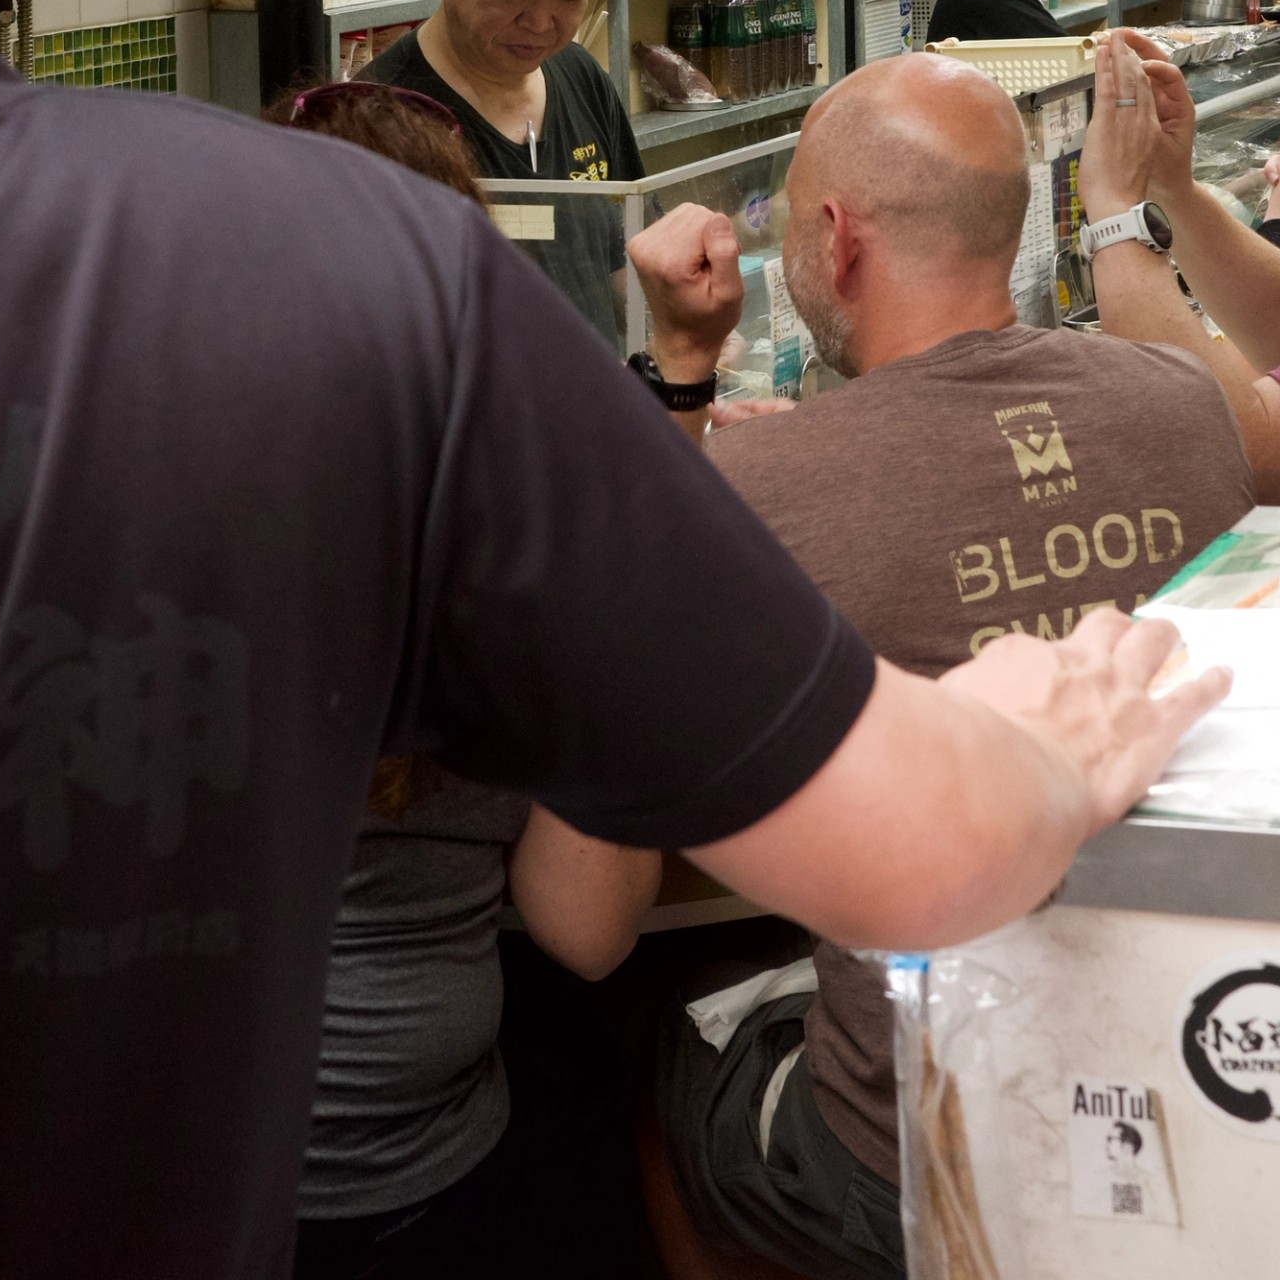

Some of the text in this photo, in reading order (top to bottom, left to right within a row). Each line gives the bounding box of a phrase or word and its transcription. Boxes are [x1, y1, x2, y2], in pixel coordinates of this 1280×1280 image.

[572, 143, 596, 162] 串カツ
[994, 401, 1055, 426] MAVERIK
[1022, 475, 1077, 502] MAN
[949, 508, 1184, 604] BLOOD
